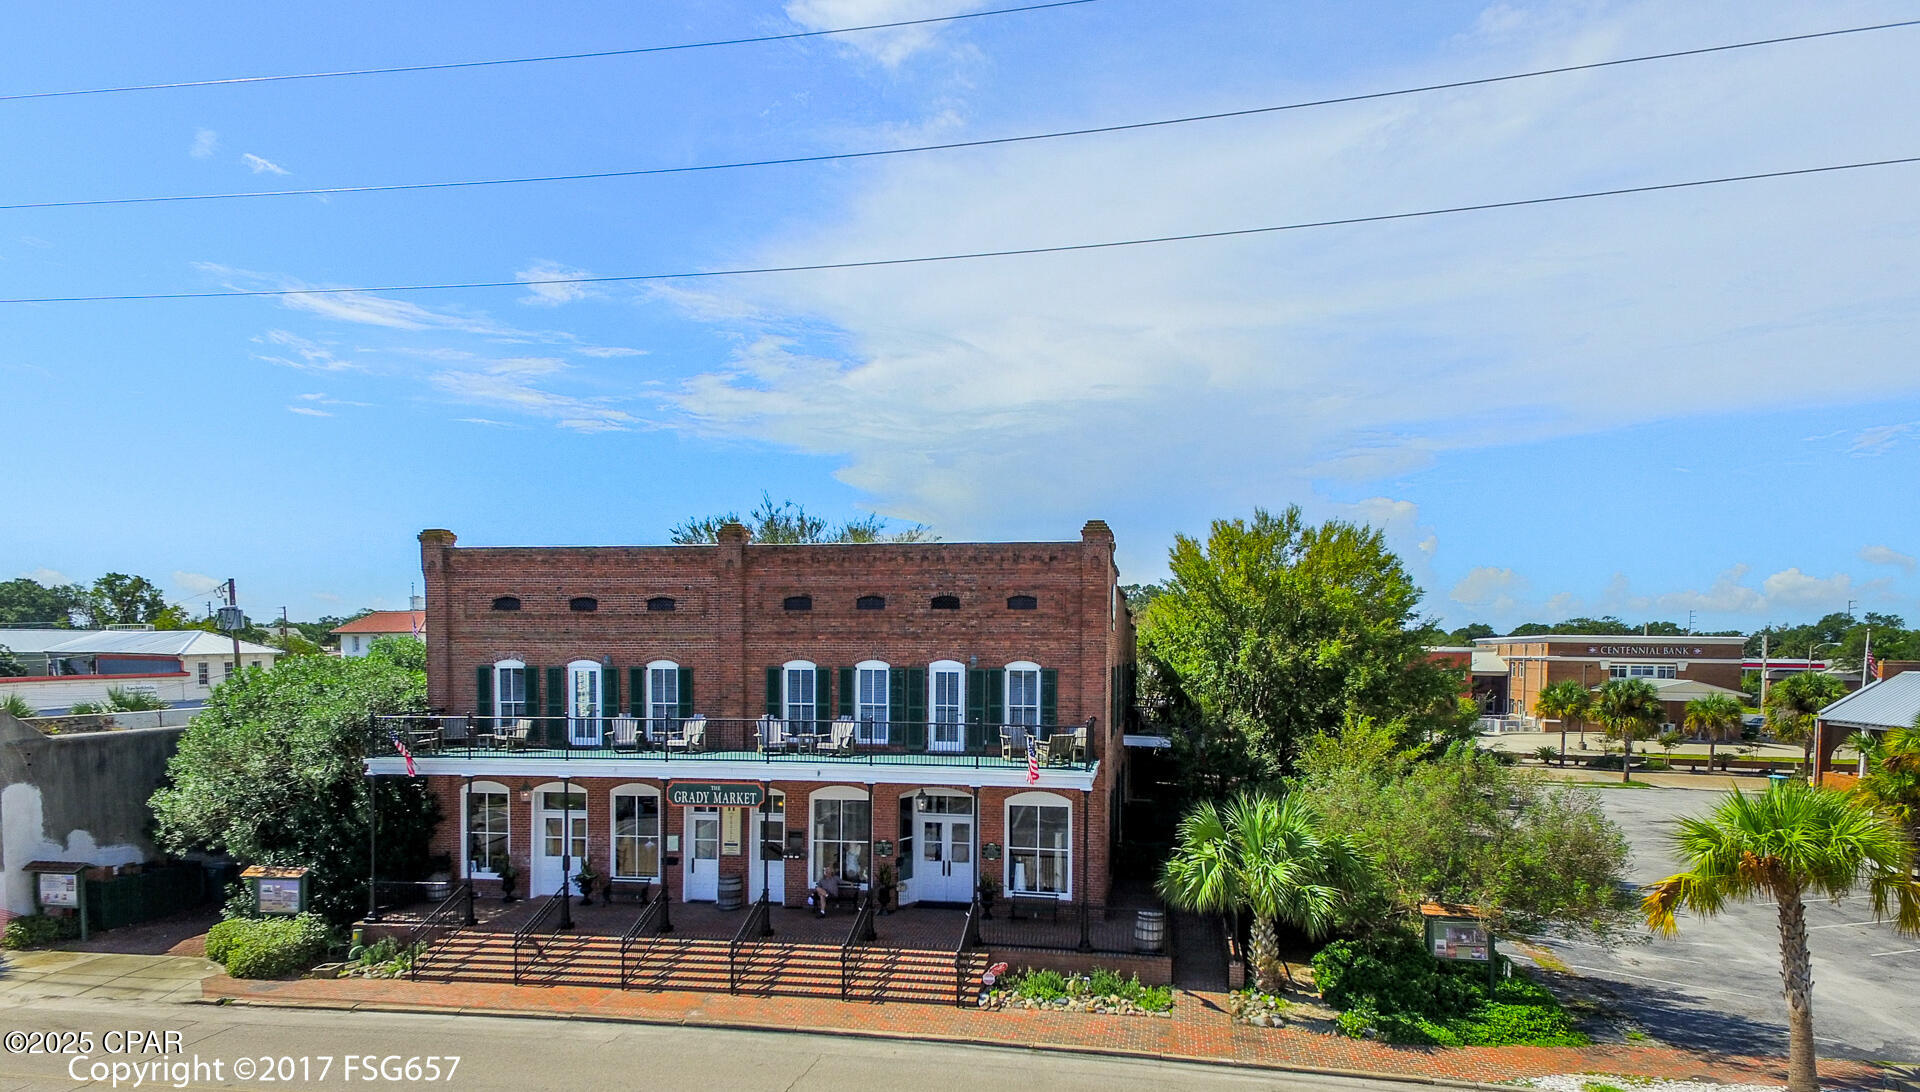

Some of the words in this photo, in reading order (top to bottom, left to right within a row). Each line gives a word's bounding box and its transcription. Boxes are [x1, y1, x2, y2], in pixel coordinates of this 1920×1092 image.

[1600, 646, 1660, 655] CENTENNIAL
[1663, 647, 1689, 655] BANK
[674, 790, 709, 803] GRADY
[713, 791, 757, 804] MARKET
